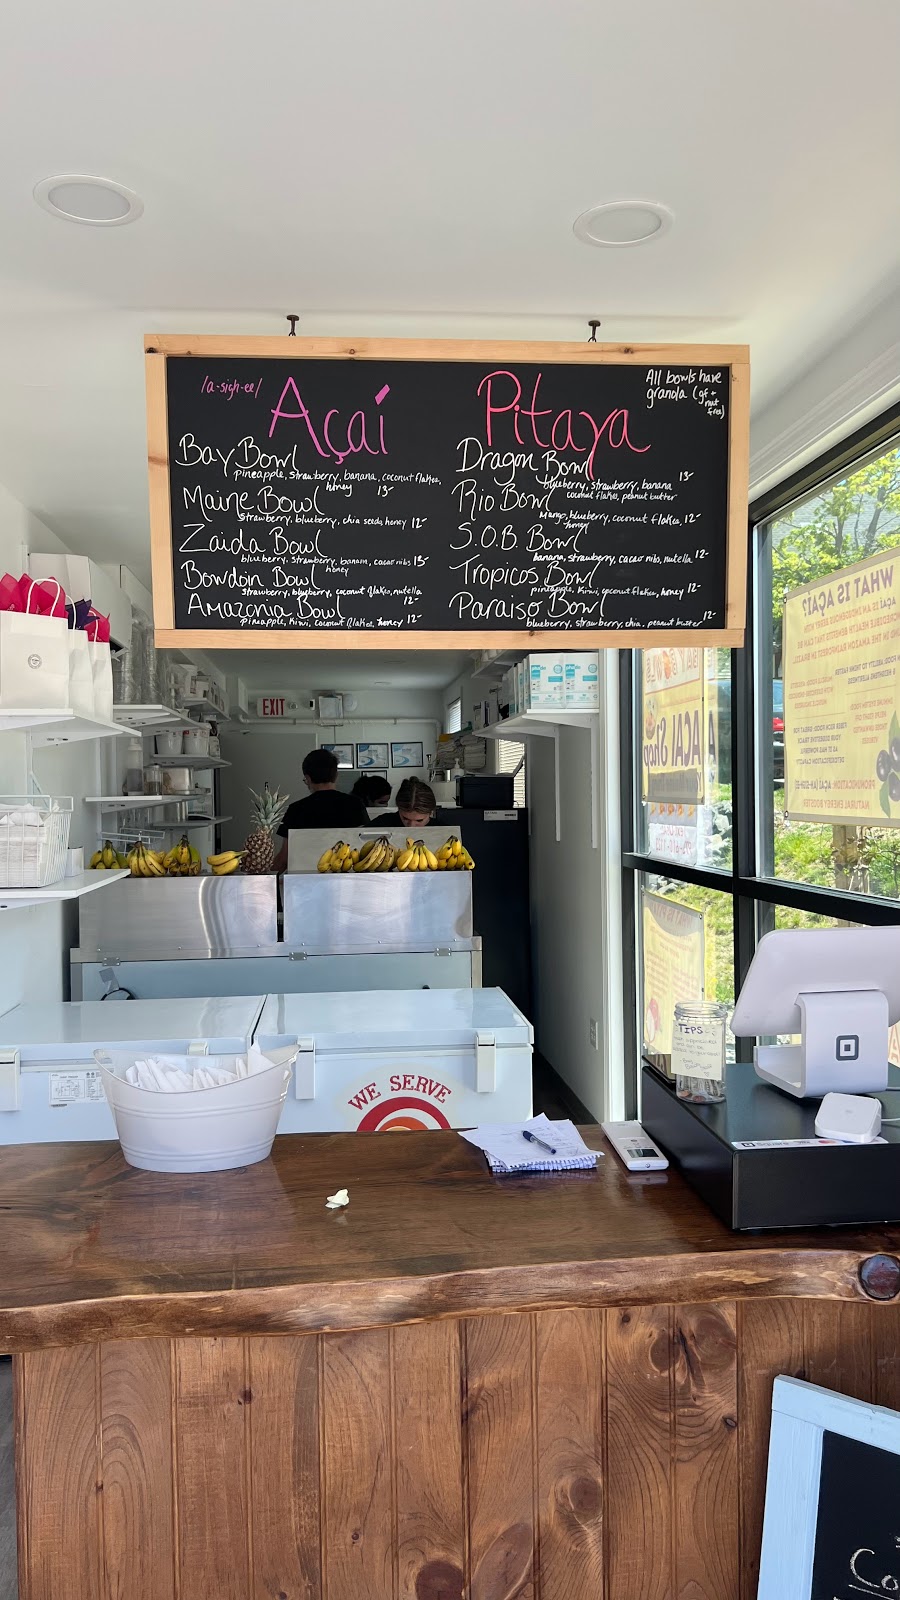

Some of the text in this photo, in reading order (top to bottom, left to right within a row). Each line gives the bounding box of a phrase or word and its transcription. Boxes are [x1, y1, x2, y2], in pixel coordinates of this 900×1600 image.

[645, 369, 722, 386] All bowls have
[646, 386, 688, 409] granola
[704, 398, 720, 407] nut
[477, 370, 651, 480] Pitaya
[175, 433, 298, 477] Bay Bowl
[455, 437, 593, 485] Dragon Bowl
[382, 473, 413, 482] coconut
[642, 480, 673, 491] banana
[326, 481, 352, 497] honey
[622, 492, 648, 503] peanut
[649, 491, 678, 501] butter
[183, 486, 325, 522] Maine Bowl
[451, 479, 555, 521] Rio Bowl
[342, 516, 360, 526] chia
[385, 516, 407, 530] honey
[612, 514, 648, 524] coconut
[564, 521, 590, 534] honey
[179, 523, 328, 558] Zaida Bowl
[449, 522, 584, 552] S.O.B. Bowl
[663, 554, 693, 564] nutella
[180, 560, 320, 590] Bowdoin Bowl
[325, 565, 349, 577] honey
[449, 554, 602, 590] Tropicos Bowl
[336, 586, 366, 596] coconut
[393, 585, 422, 596] nutella
[661, 587, 684, 600] honey
[187, 593, 346, 620] Amazonia Bowl
[449, 590, 605, 620] Paraiso Bowl
[313, 618, 346, 628] coconut
[377, 617, 403, 628] honey
[647, 618, 675, 629] peanut
[675, 619, 703, 628] butter
[263, 698, 285, 715] EXIT
[678, 1023, 704, 1034] TIPS
[348, 1074, 452, 1110] WE SERVE
